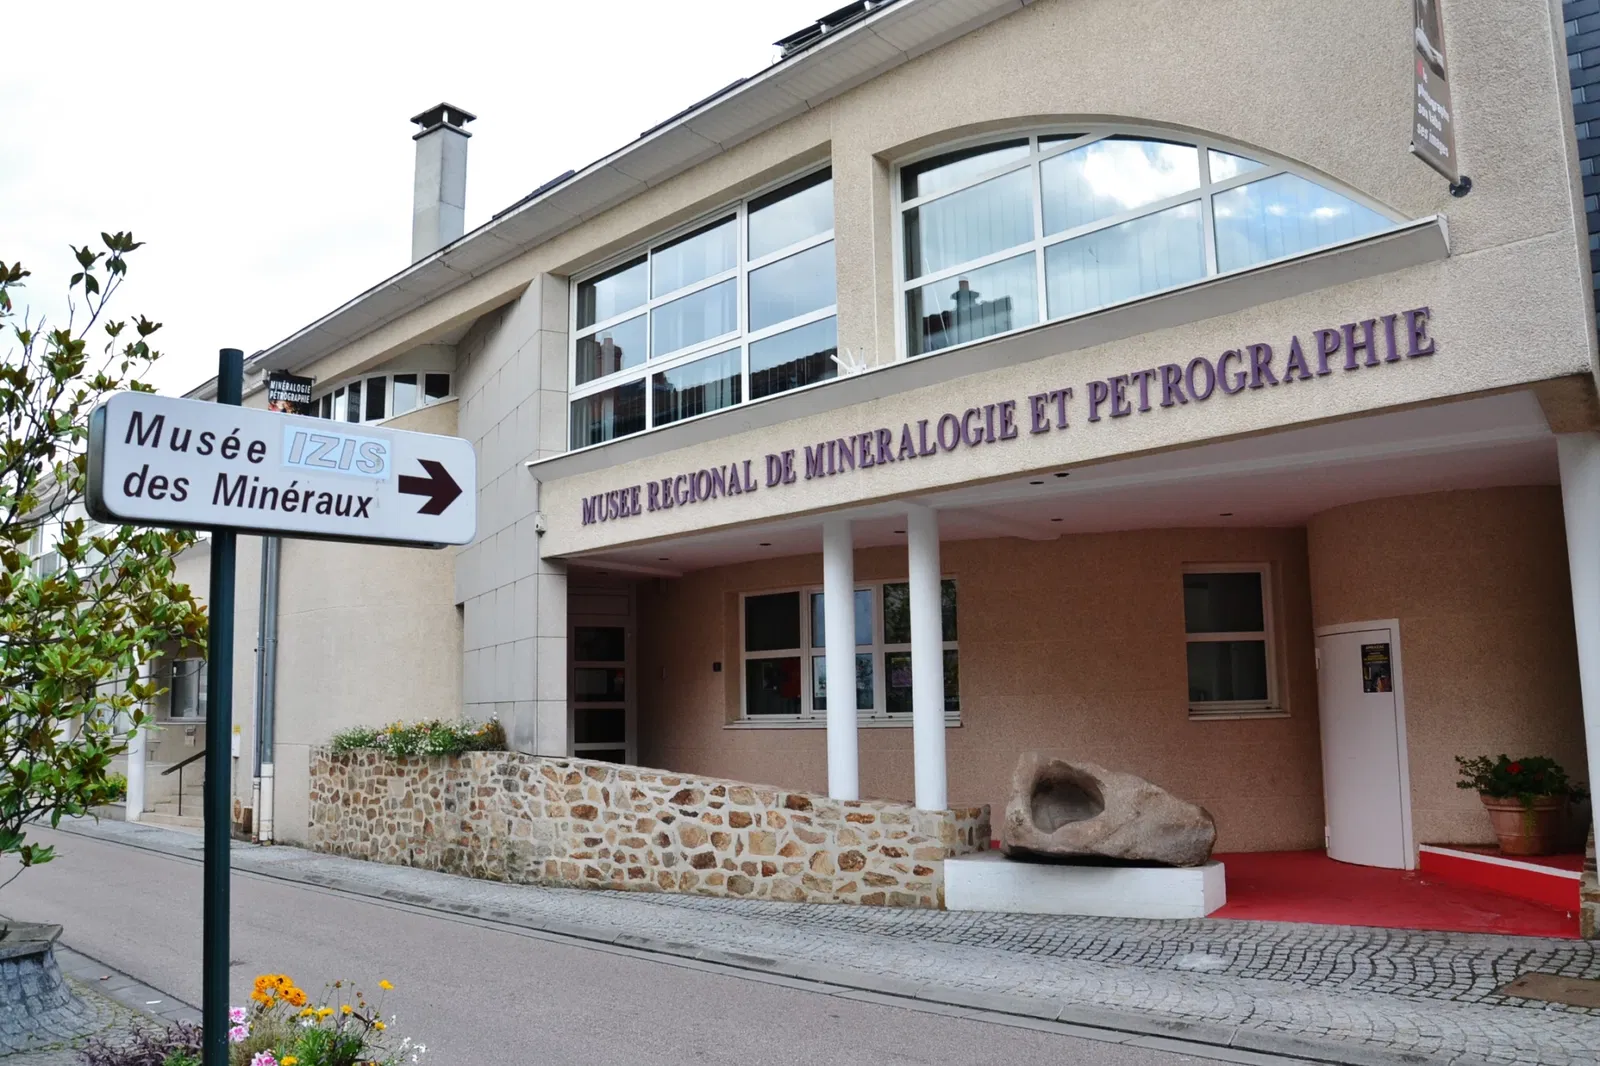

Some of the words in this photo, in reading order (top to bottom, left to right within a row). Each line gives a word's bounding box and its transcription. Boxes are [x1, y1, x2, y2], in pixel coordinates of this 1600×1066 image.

[1417, 123, 1428, 139] ses
[269, 389, 310, 404] PÉTROGRAPHIE
[270, 380, 311, 393] MINÉRALOGIE
[581, 484, 642, 526] MUSEE
[646, 459, 757, 512] REGIONAL
[765, 448, 796, 487] DE
[804, 400, 1017, 480] MINERALOGIE
[1028, 387, 1073, 434] ET
[1086, 306, 1436, 423] PETROGRAPHIE
[124, 410, 267, 465] Musée
[288, 431, 387, 475] IZIS
[123, 463, 190, 503] des
[212, 472, 373, 519] Minéraux
